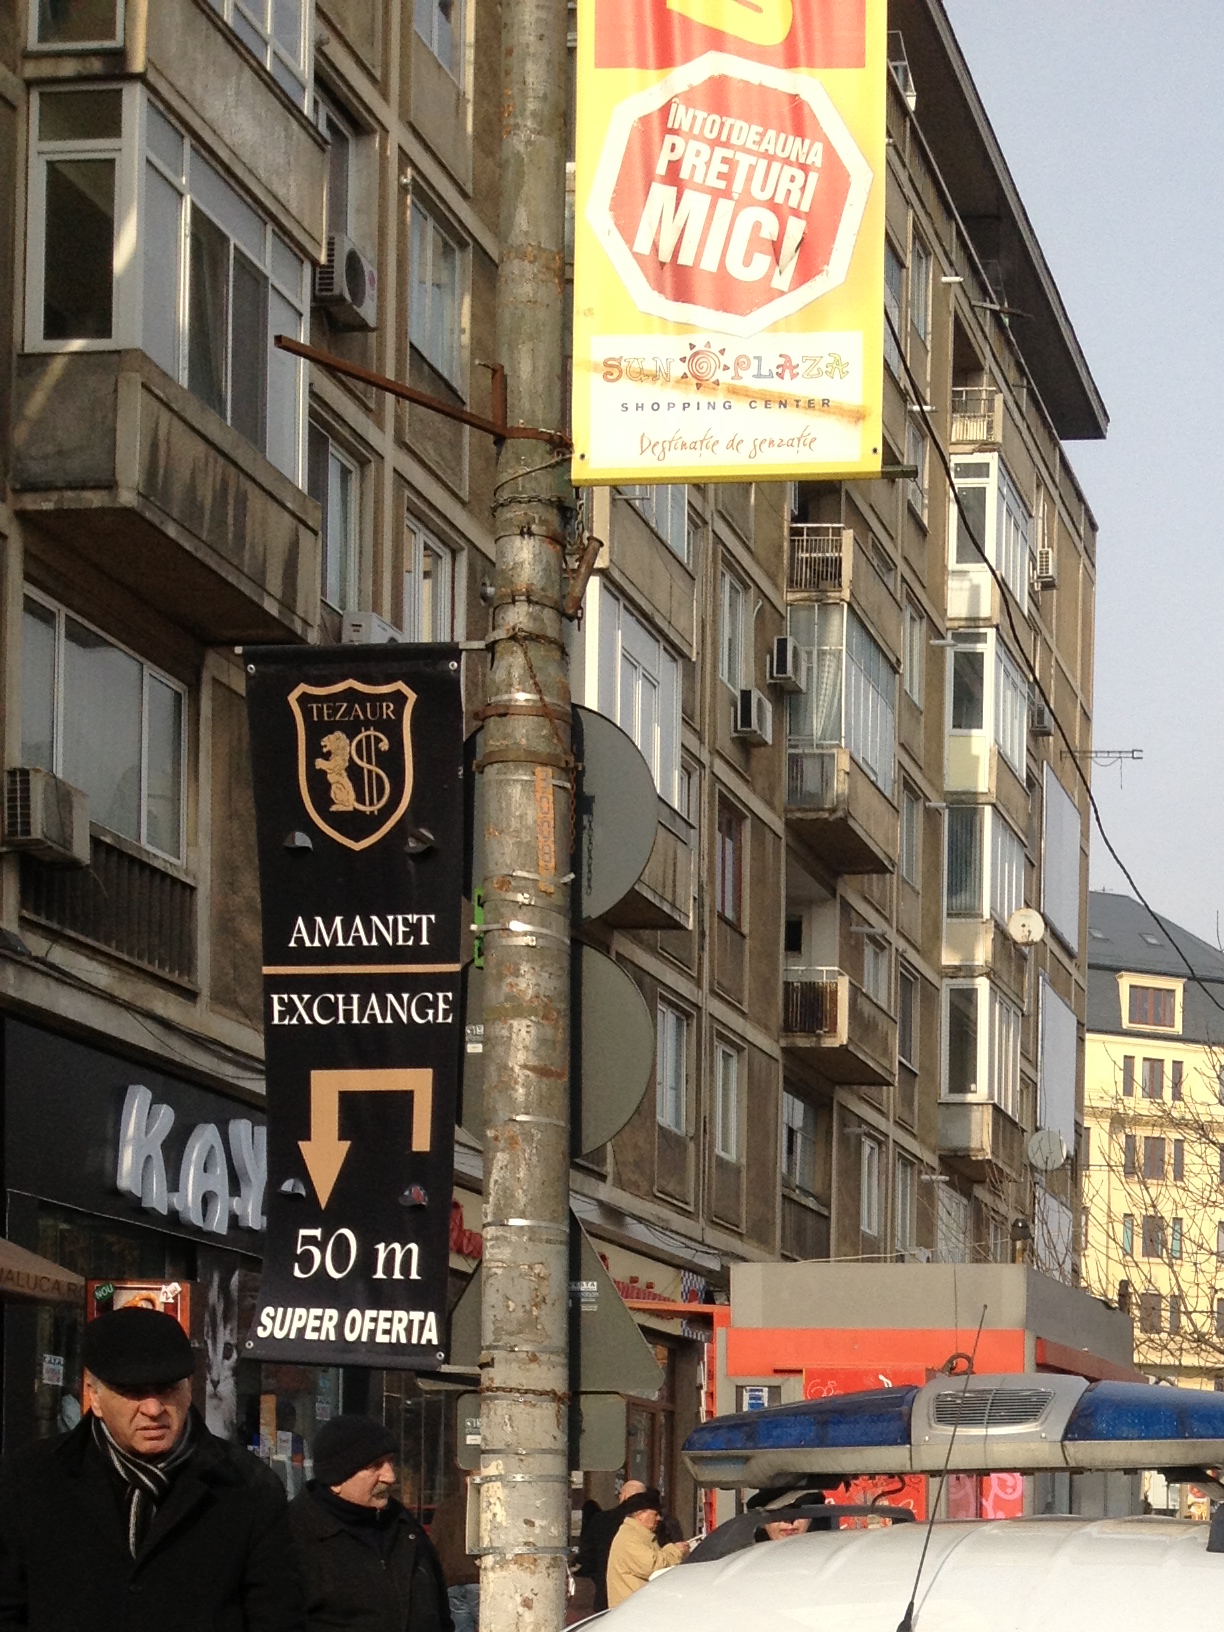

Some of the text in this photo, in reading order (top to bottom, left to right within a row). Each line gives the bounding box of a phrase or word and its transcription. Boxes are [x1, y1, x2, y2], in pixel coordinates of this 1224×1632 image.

[603, 353, 849, 382] SUN PLAZA
[621, 398, 831, 412] SHOPPING CENTER
[725, 433, 744, 453] de
[308, 702, 395, 721] TEZAUR
[288, 914, 435, 947] AMANET
[270, 992, 453, 1025] EXCHANGE
[293, 1228, 422, 1279] 50 m
[257, 1306, 438, 1345] SUPER OFERTA
